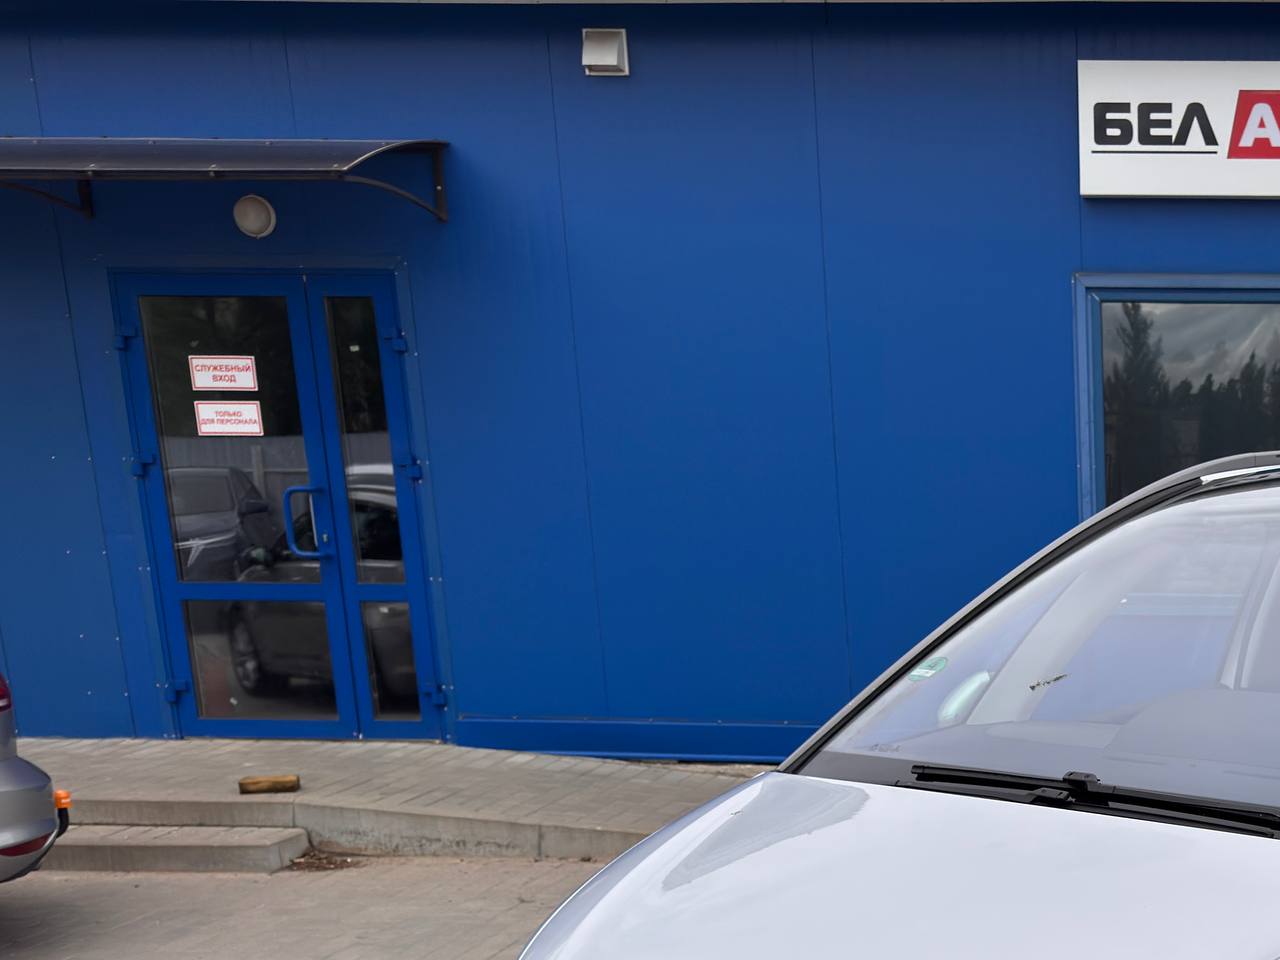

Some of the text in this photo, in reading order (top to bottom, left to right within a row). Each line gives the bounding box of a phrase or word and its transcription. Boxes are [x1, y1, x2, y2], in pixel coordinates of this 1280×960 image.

[1093, 102, 1219, 146] БЕЛ
[194, 364, 251, 373] СЛУЖЕБНЫЙ
[212, 374, 237, 383] ВХОД
